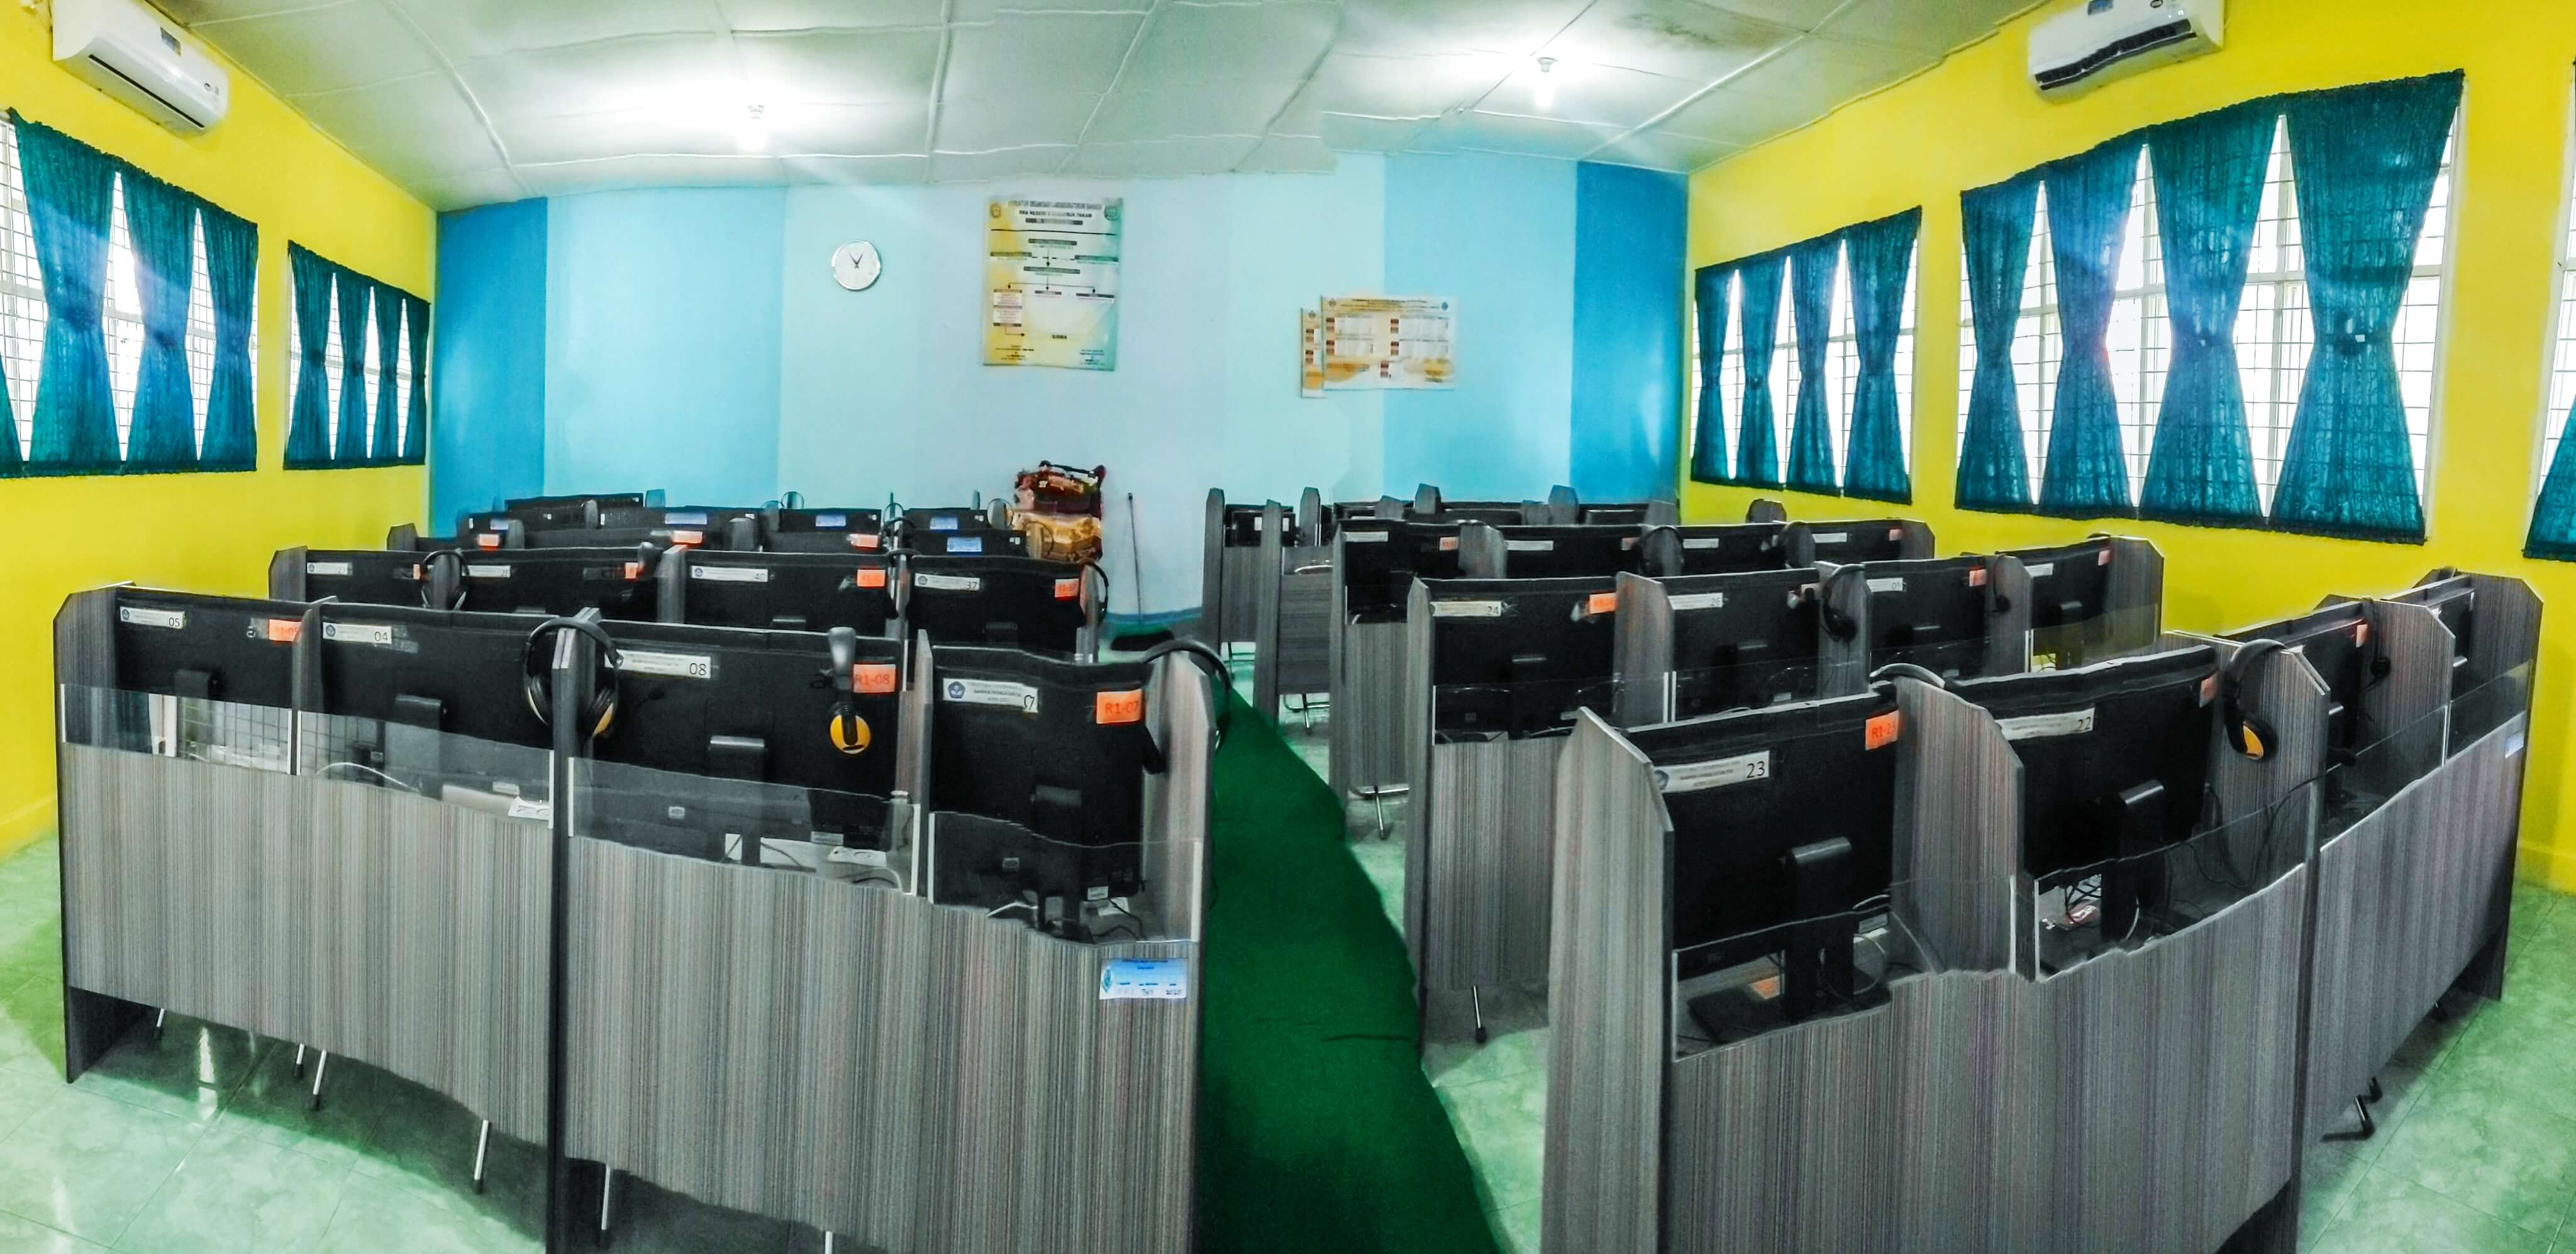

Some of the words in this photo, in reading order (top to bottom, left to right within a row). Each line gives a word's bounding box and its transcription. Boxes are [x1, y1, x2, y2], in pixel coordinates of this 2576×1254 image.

[966, 581, 977, 589] 37
[1486, 606, 1499, 614] 24
[169, 617, 180, 627] 05
[374, 631, 388, 641] 04
[689, 663, 707, 675] 08
[854, 674, 890, 685] R1-08
[1106, 700, 1138, 714] R1-07
[2074, 716, 2091, 731] 22
[1746, 761, 1765, 779] 23
